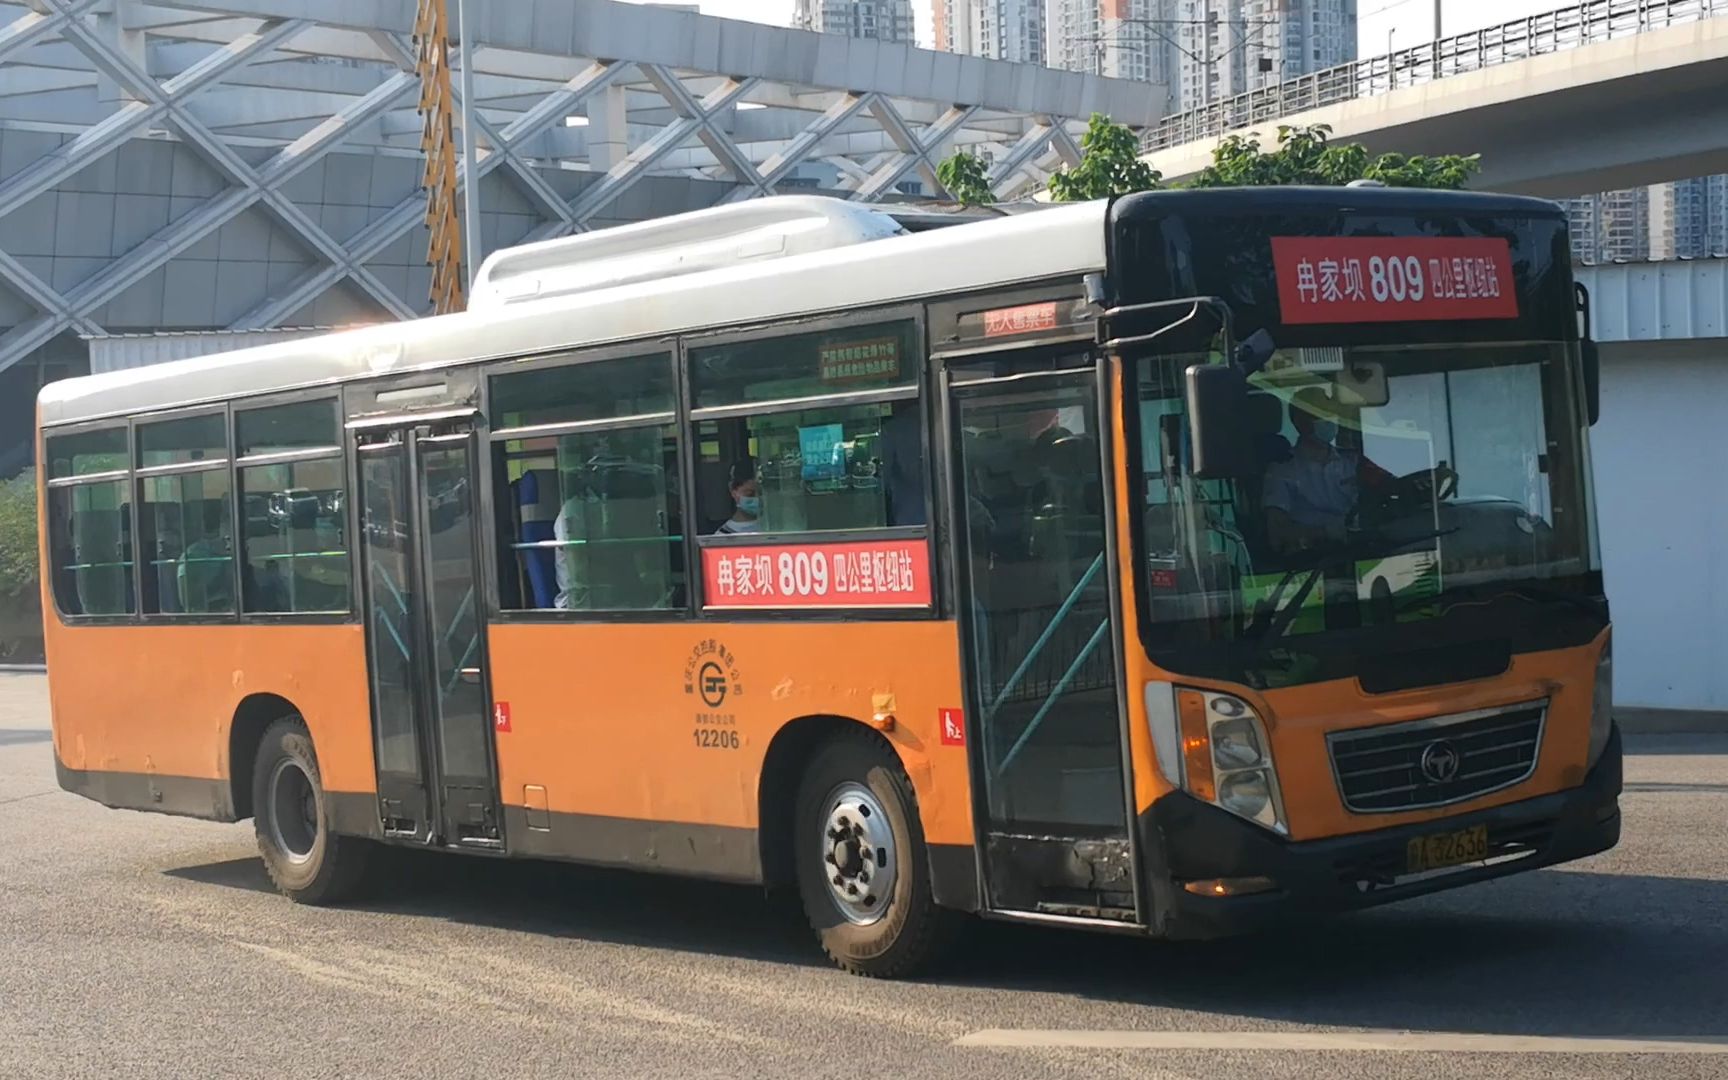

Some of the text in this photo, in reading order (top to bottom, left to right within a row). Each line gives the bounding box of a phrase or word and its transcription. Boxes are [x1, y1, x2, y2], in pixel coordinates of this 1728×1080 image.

[1296, 255, 1500, 303] 冉家坝 809 四公里枢纽站
[717, 549, 914, 596] 冉家坝 809 四公里枢纽站
[693, 728, 740, 750] 12206
